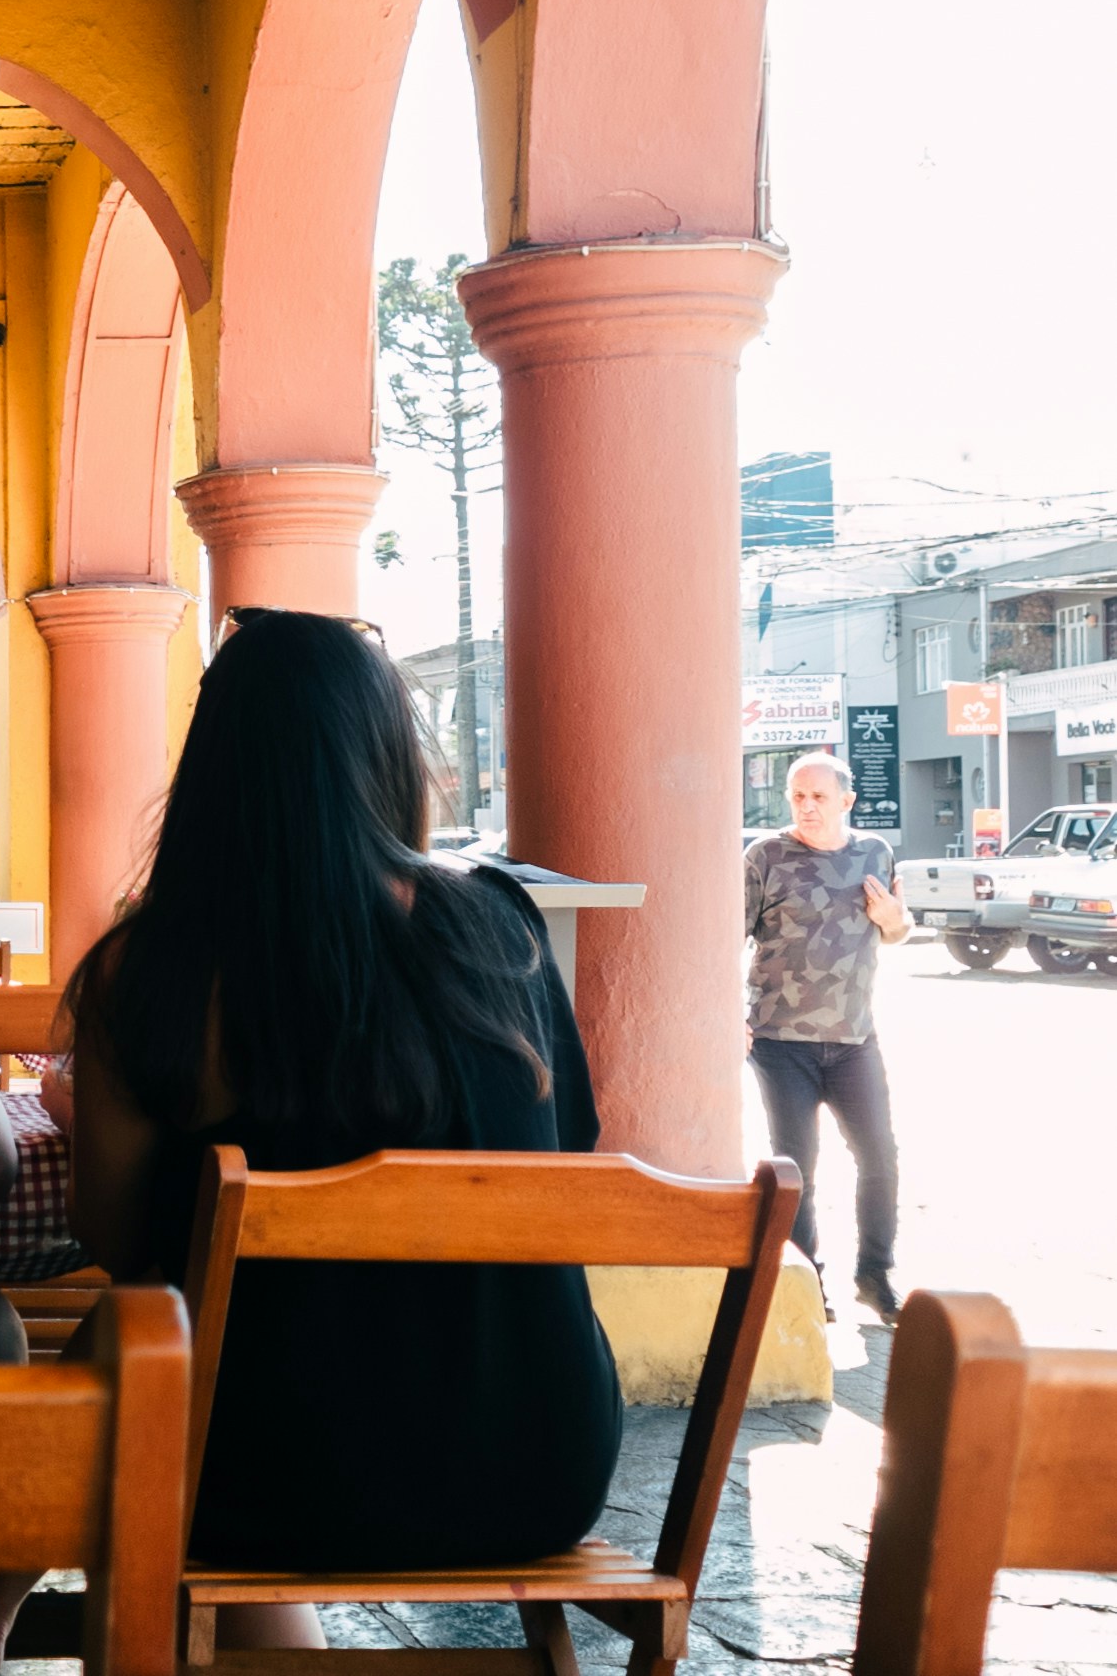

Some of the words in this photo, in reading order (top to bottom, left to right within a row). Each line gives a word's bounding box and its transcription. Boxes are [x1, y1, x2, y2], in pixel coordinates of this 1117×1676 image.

[742, 700, 829, 728] Sabrina
[1091, 718, 1116, 735] Você
[763, 729, 828, 742] 3372-2477
